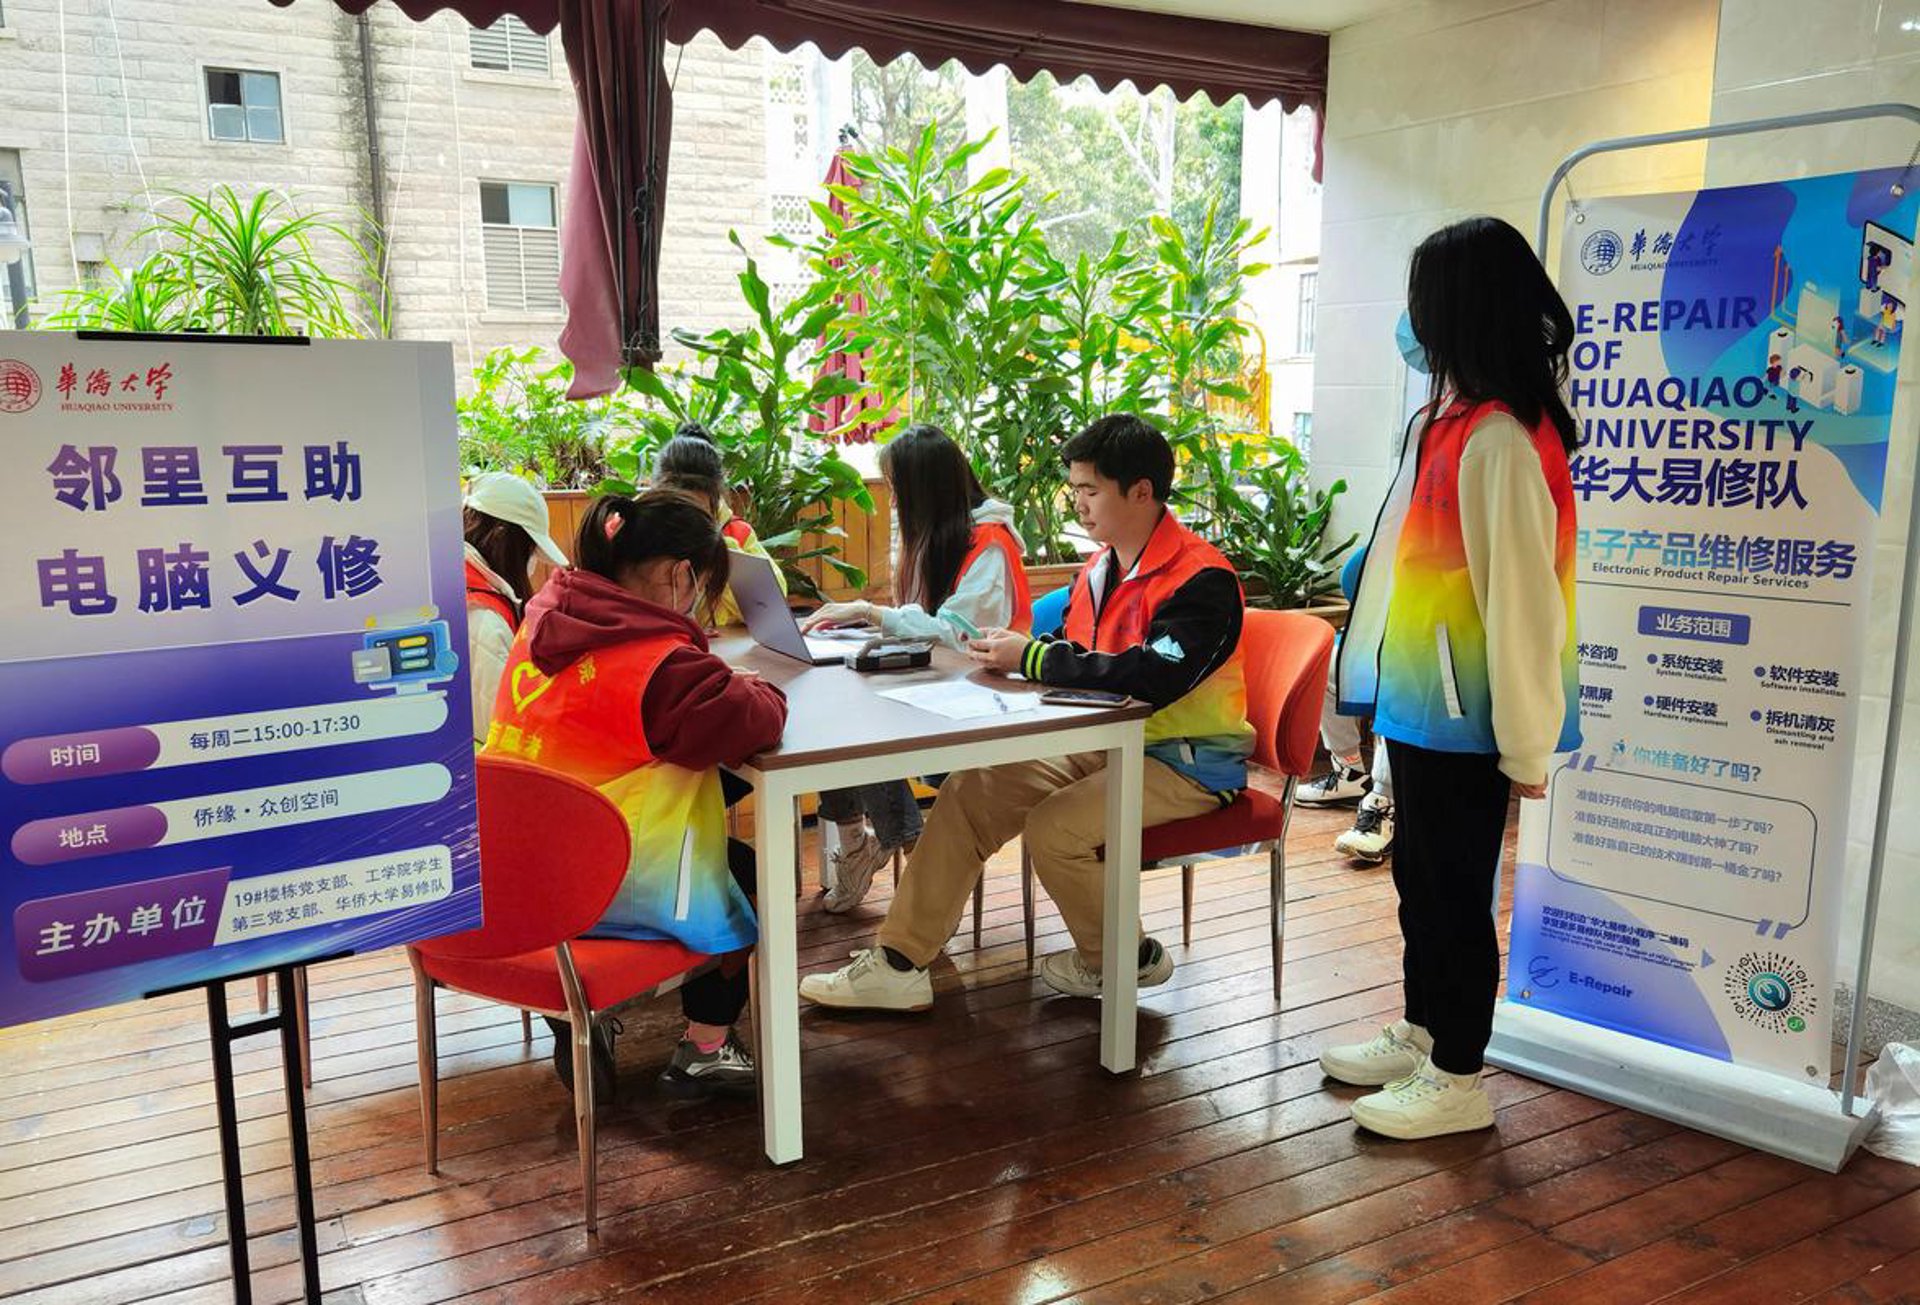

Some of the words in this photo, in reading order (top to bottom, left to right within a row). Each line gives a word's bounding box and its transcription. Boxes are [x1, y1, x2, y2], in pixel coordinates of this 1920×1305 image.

[1575, 296, 1758, 335] E-REPAIR
[1573, 340, 1622, 371] OF
[61, 402, 110, 412] HUAQIAO
[113, 401, 173, 411] UNIVERSITY
[1570, 376, 1764, 411] HUAQIAO
[47, 442, 363, 512] 邻里互助
[1569, 455, 1808, 510] 华大易修队
[36, 534, 383, 616] 电脑义修
[1592, 562, 1650, 577] Electronic
[1654, 567, 1703, 582] Product
[1707, 571, 1749, 586] Repair
[1752, 574, 1809, 590] Services
[1655, 612, 1731, 639] 业务范围
[1661, 653, 1724, 674] 系统安装
[1769, 665, 1840, 687] 软件安装
[1656, 695, 1718, 717] 硬件安装
[189, 714, 360, 750] 每周二15:00-17:30
[1766, 709, 1835, 733] 拆机清灰
[51, 743, 101, 767] 时间
[58, 824, 109, 848] 地点
[36, 895, 206, 956] 主办单位
[1569, 970, 1634, 998] E-Repair
